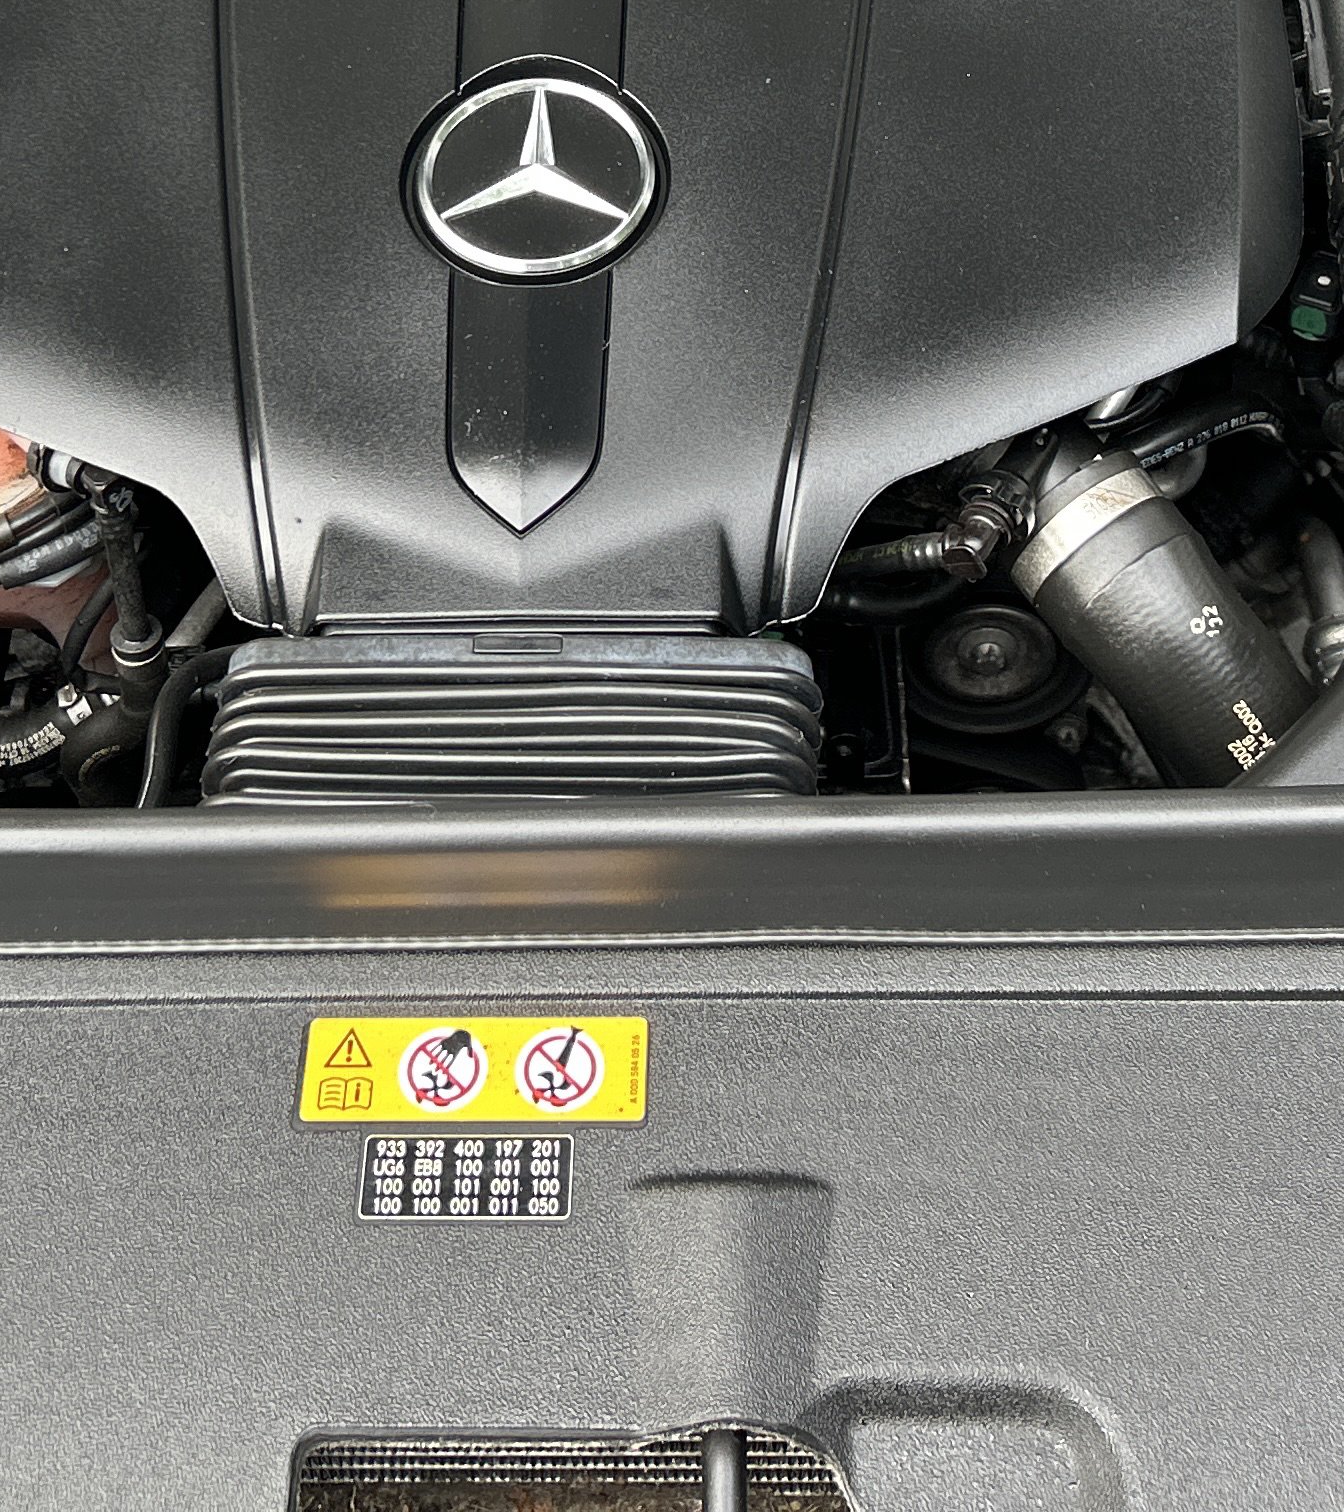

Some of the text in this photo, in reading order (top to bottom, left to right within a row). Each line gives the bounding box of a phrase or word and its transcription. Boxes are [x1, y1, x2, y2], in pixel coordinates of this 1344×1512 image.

[1232, 699, 1262, 734] Q002
[631, 1034, 640, 1046] 26
[377, 1140, 560, 1158] 933 392 400 197 201
[373, 1159, 405, 1176] UG6
[456, 1159, 482, 1176] 100
[494, 1159, 520, 1176] 101
[531, 1159, 559, 1177] 001
[376, 1178, 560, 1196] 100 001 101 001 100
[374, 1197, 559, 1215] 100 100 001 011 050
